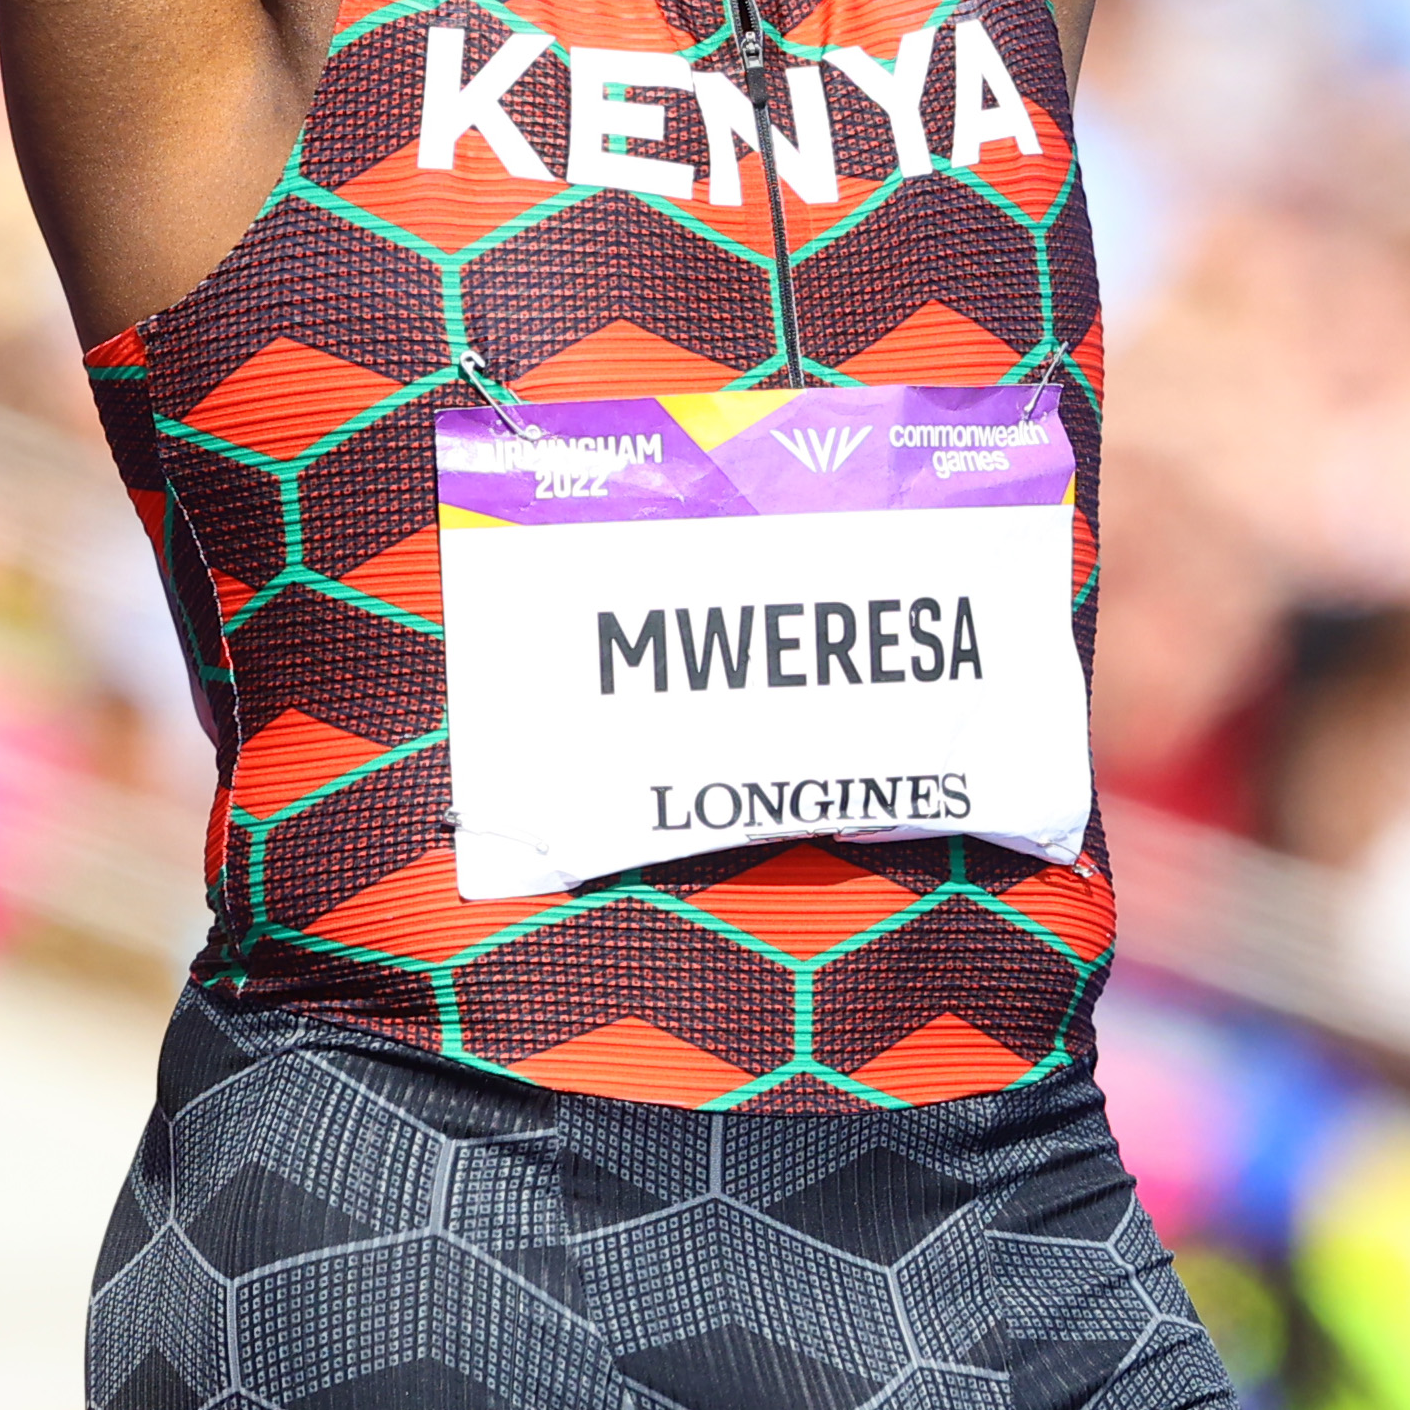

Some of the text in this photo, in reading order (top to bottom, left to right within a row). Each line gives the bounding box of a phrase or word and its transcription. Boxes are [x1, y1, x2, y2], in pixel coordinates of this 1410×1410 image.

[416, 19, 1043, 207] KENYA
[889, 422, 1049, 448] commonwealth
[534, 468, 608, 499] 2022
[932, 450, 1010, 478] games
[597, 596, 983, 695] MWERESA
[650, 773, 972, 831] LONGINES
